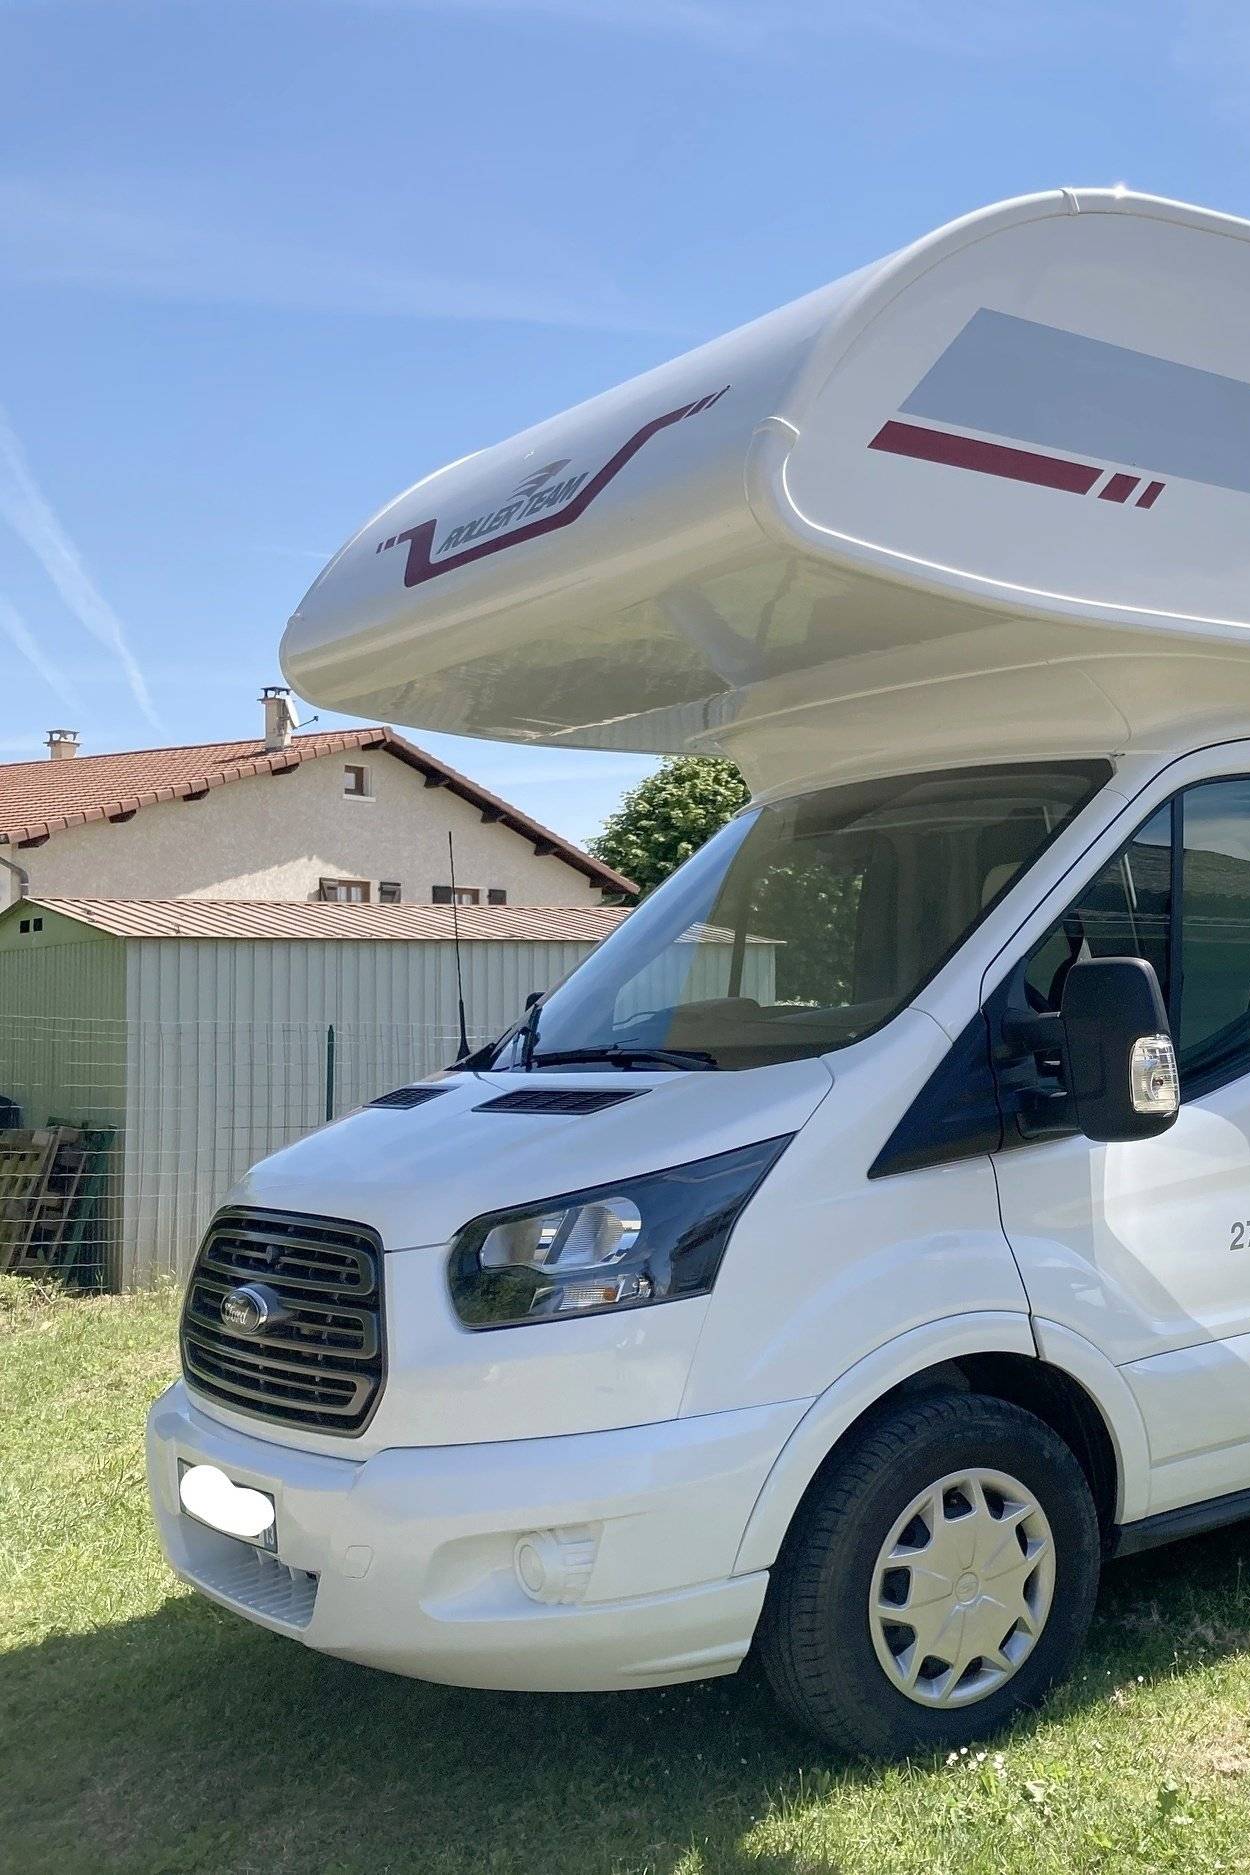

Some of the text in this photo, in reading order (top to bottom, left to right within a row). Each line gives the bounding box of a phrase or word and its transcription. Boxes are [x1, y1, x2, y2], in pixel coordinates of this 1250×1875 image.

[436, 472, 589, 555] ROLLER TEAM
[224, 1302, 250, 1325] Ford
